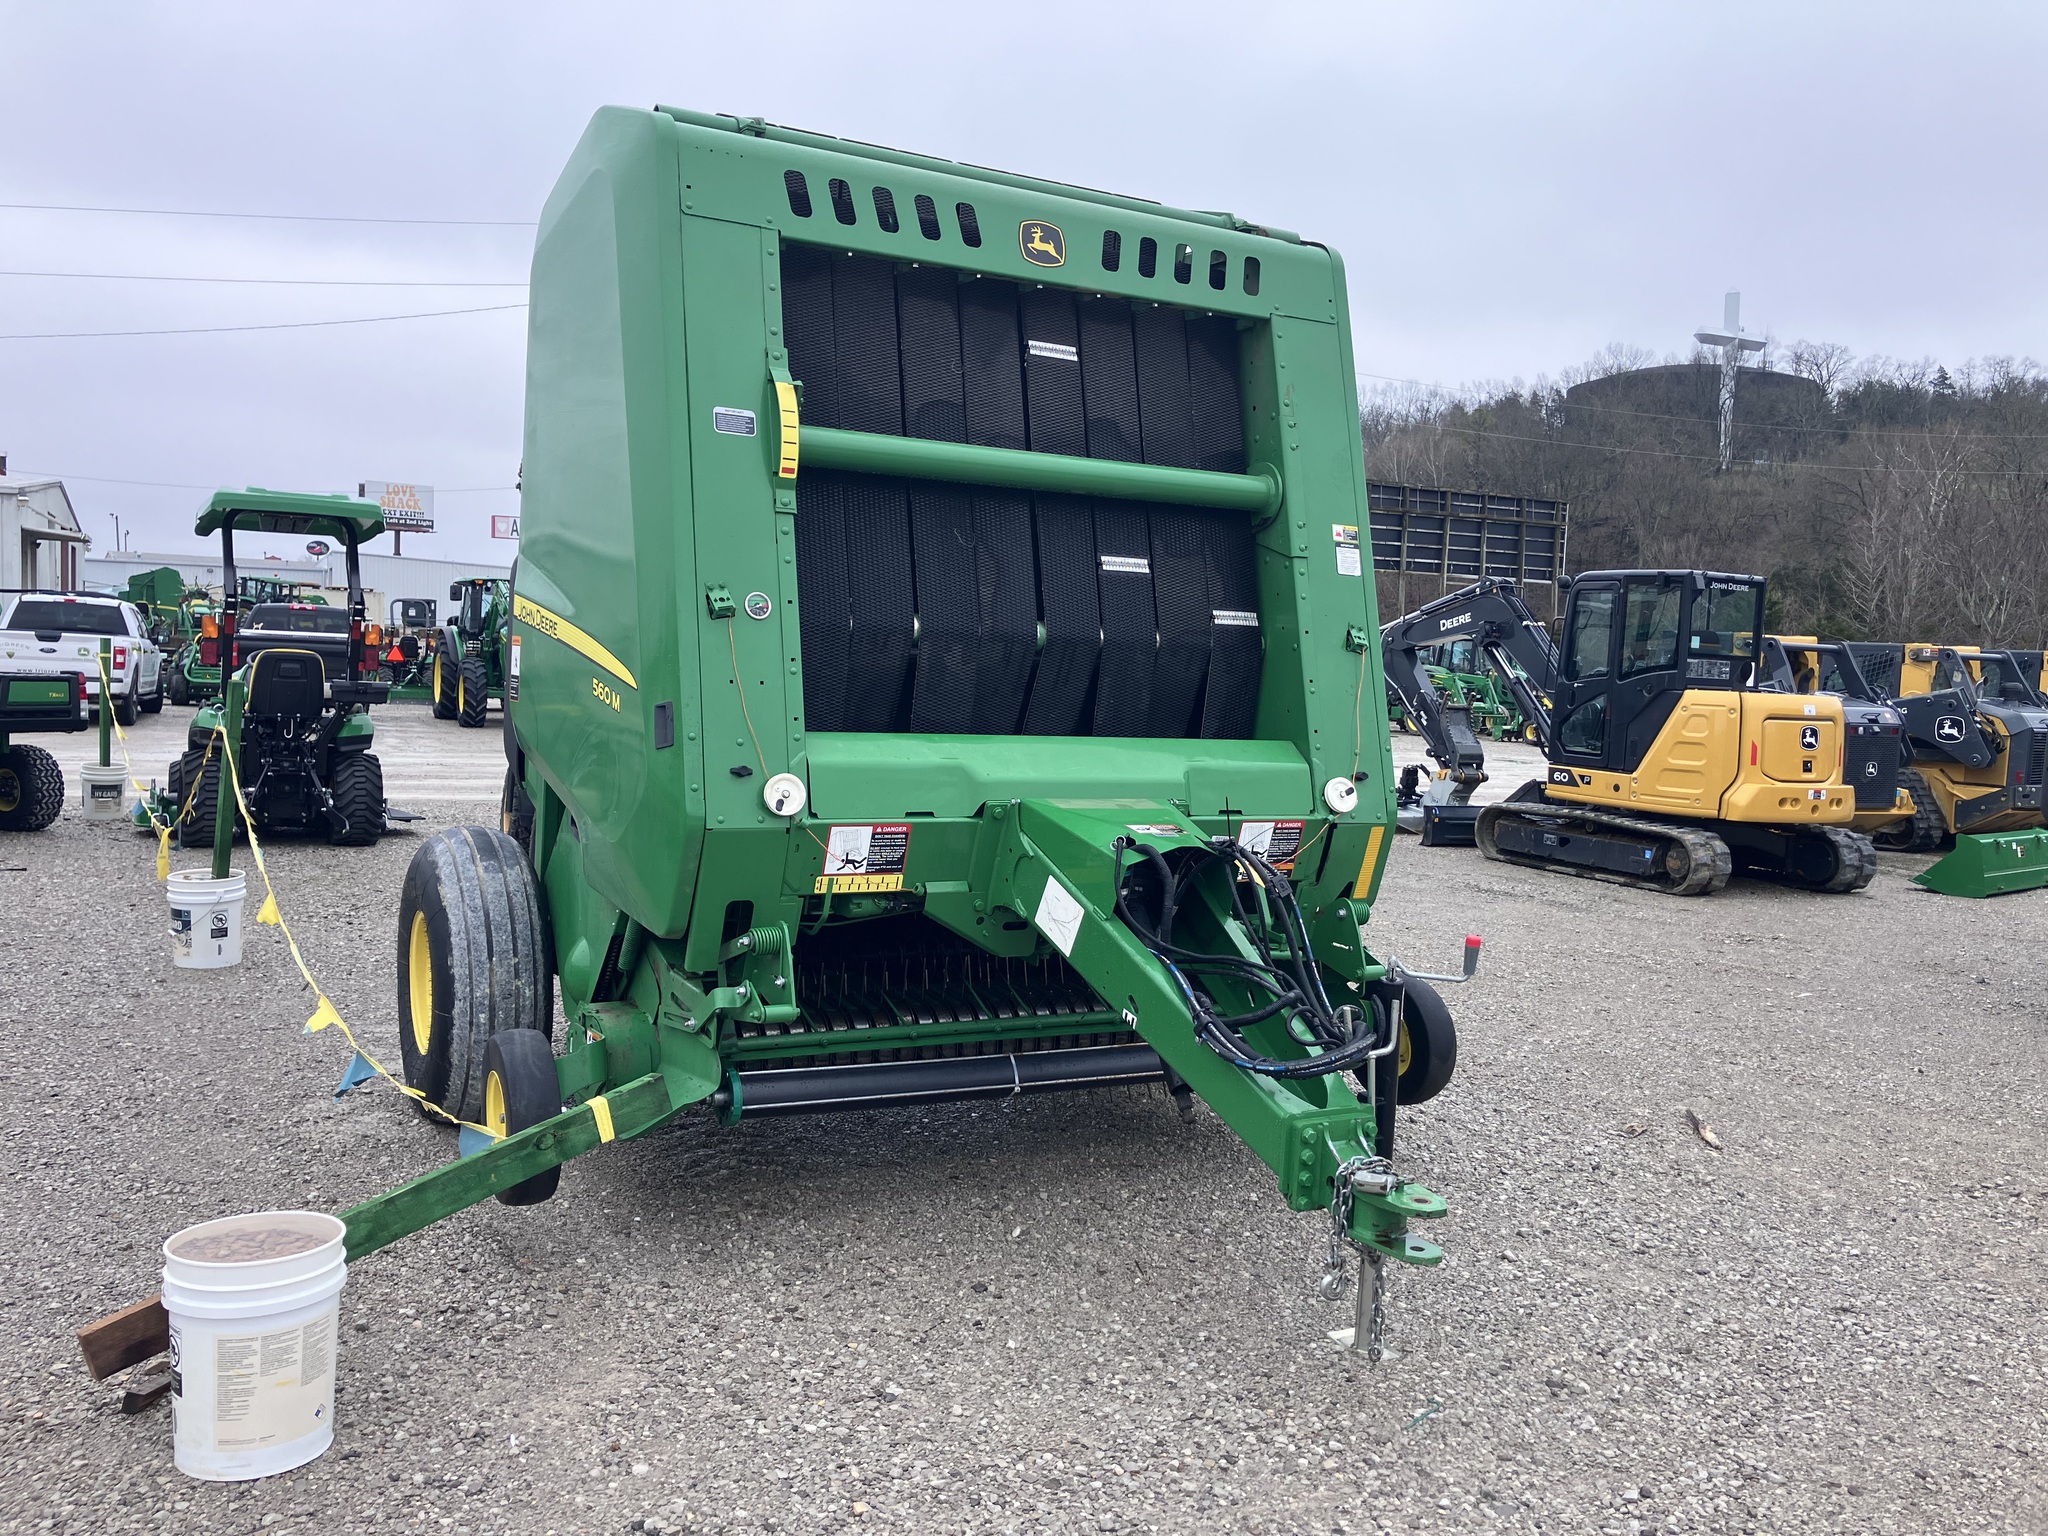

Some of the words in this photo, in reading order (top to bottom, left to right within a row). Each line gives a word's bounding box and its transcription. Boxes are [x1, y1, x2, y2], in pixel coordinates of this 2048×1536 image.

[385, 483, 416, 498] LOVE
[380, 496, 422, 510] SHACK
[382, 508, 396, 516] EXT
[1710, 581, 1727, 591] JOHN
[1728, 582, 1749, 592] DEERE
[518, 602, 536, 625] JOHN
[536, 609, 558, 637] DEERE
[1440, 612, 1472, 632] DEERE
[592, 677, 611, 705] 560
[611, 690, 621, 714] M
[1553, 771, 1569, 782] 60
